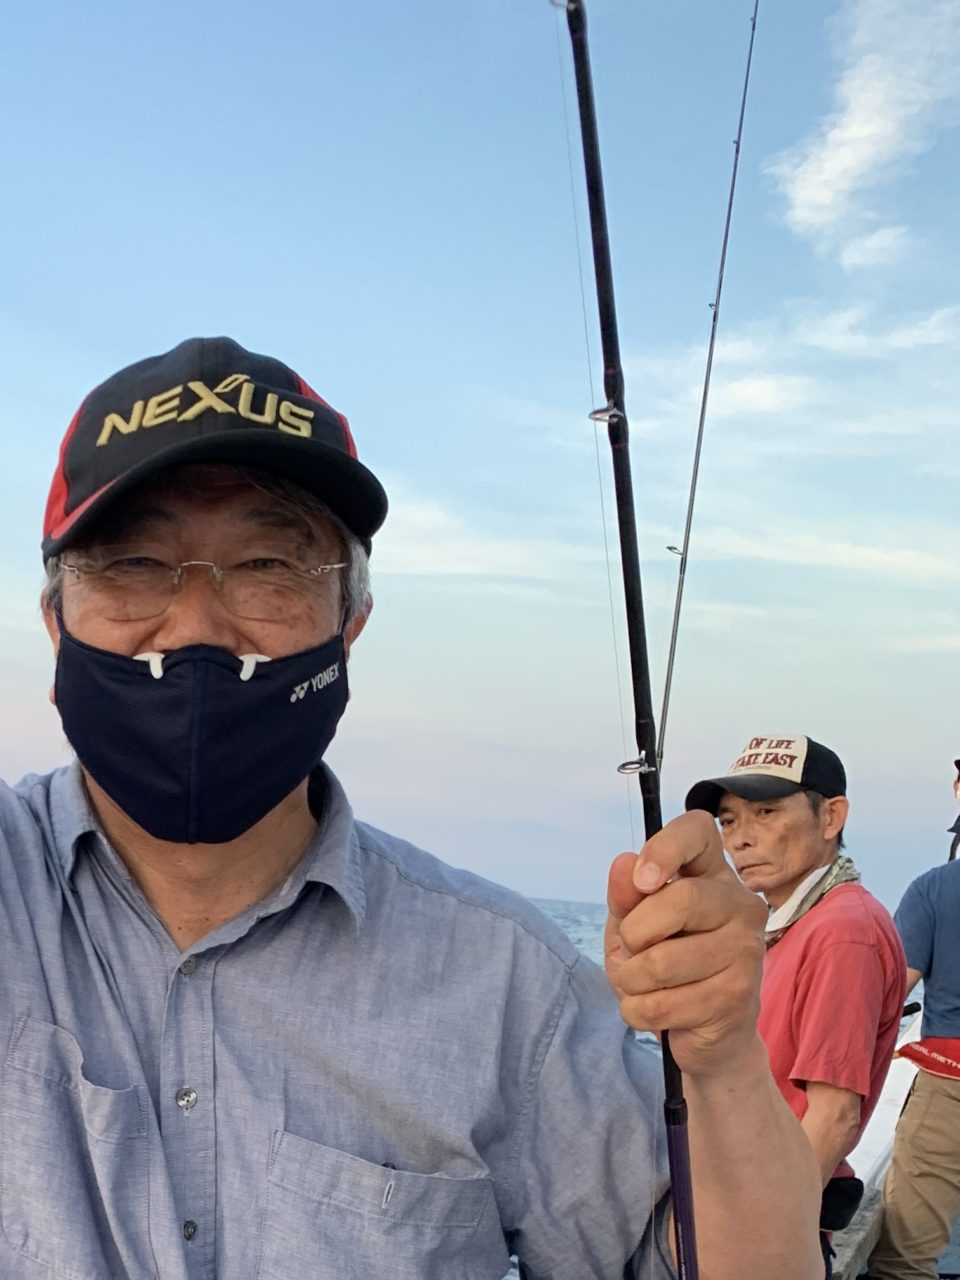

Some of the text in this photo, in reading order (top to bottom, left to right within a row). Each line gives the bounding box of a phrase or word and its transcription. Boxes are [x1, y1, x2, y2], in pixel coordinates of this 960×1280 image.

[96, 373, 315, 447] NEXUS
[311, 662, 340, 693] YONEX
[762, 752, 798, 768] EASY
